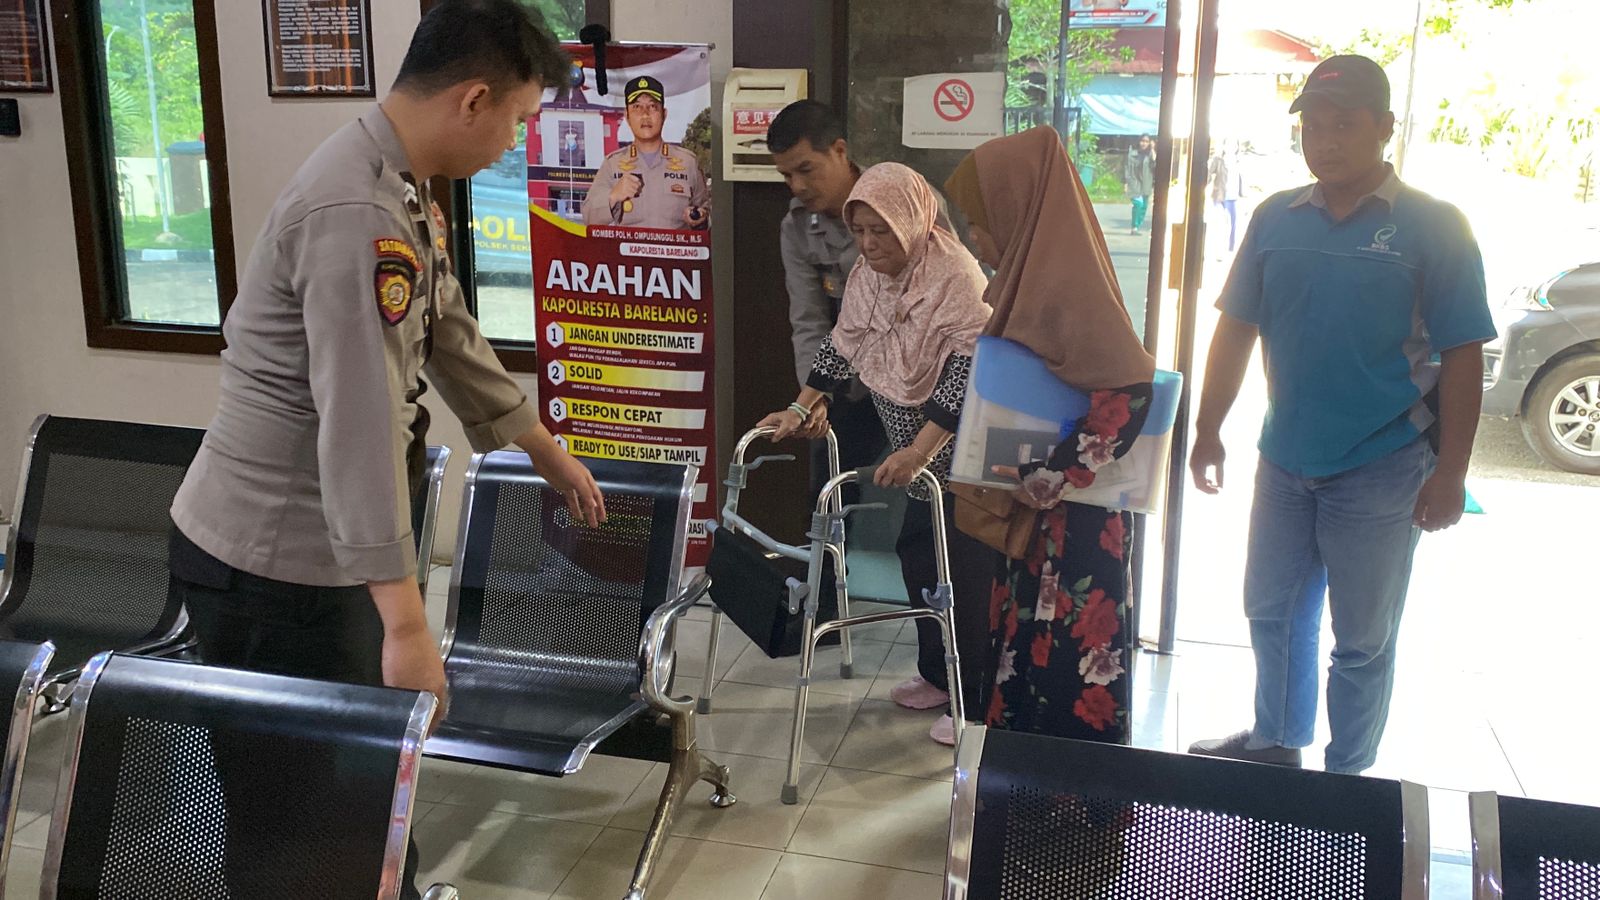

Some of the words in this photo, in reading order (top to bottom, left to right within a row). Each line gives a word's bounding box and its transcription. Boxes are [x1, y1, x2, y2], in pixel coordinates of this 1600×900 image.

[664, 172, 688, 180] POLRI
[592, 229, 614, 238] KOMBES
[615, 230, 626, 239] POL
[629, 246, 665, 256] KAPOLRESTA
[666, 248, 698, 257] BARELANG
[546, 260, 701, 300] ARAHAN
[542, 296, 620, 319] KAPOLRESTA
[624, 304, 698, 324] BARELANG
[551, 328, 558, 342] 1
[569, 327, 609, 343] JANGAN
[612, 331, 695, 349] UNDERESTIMATE
[551, 366, 560, 380] 2
[569, 365, 602, 380] SOLID
[553, 403, 561, 417] 3
[572, 403, 620, 419] RESPON
[624, 408, 662, 423] CEPAT
[573, 439, 600, 454] READY
[602, 443, 616, 456] TO
[618, 445, 661, 460] USE/SIAP
[664, 449, 700, 463] TAMPIL
